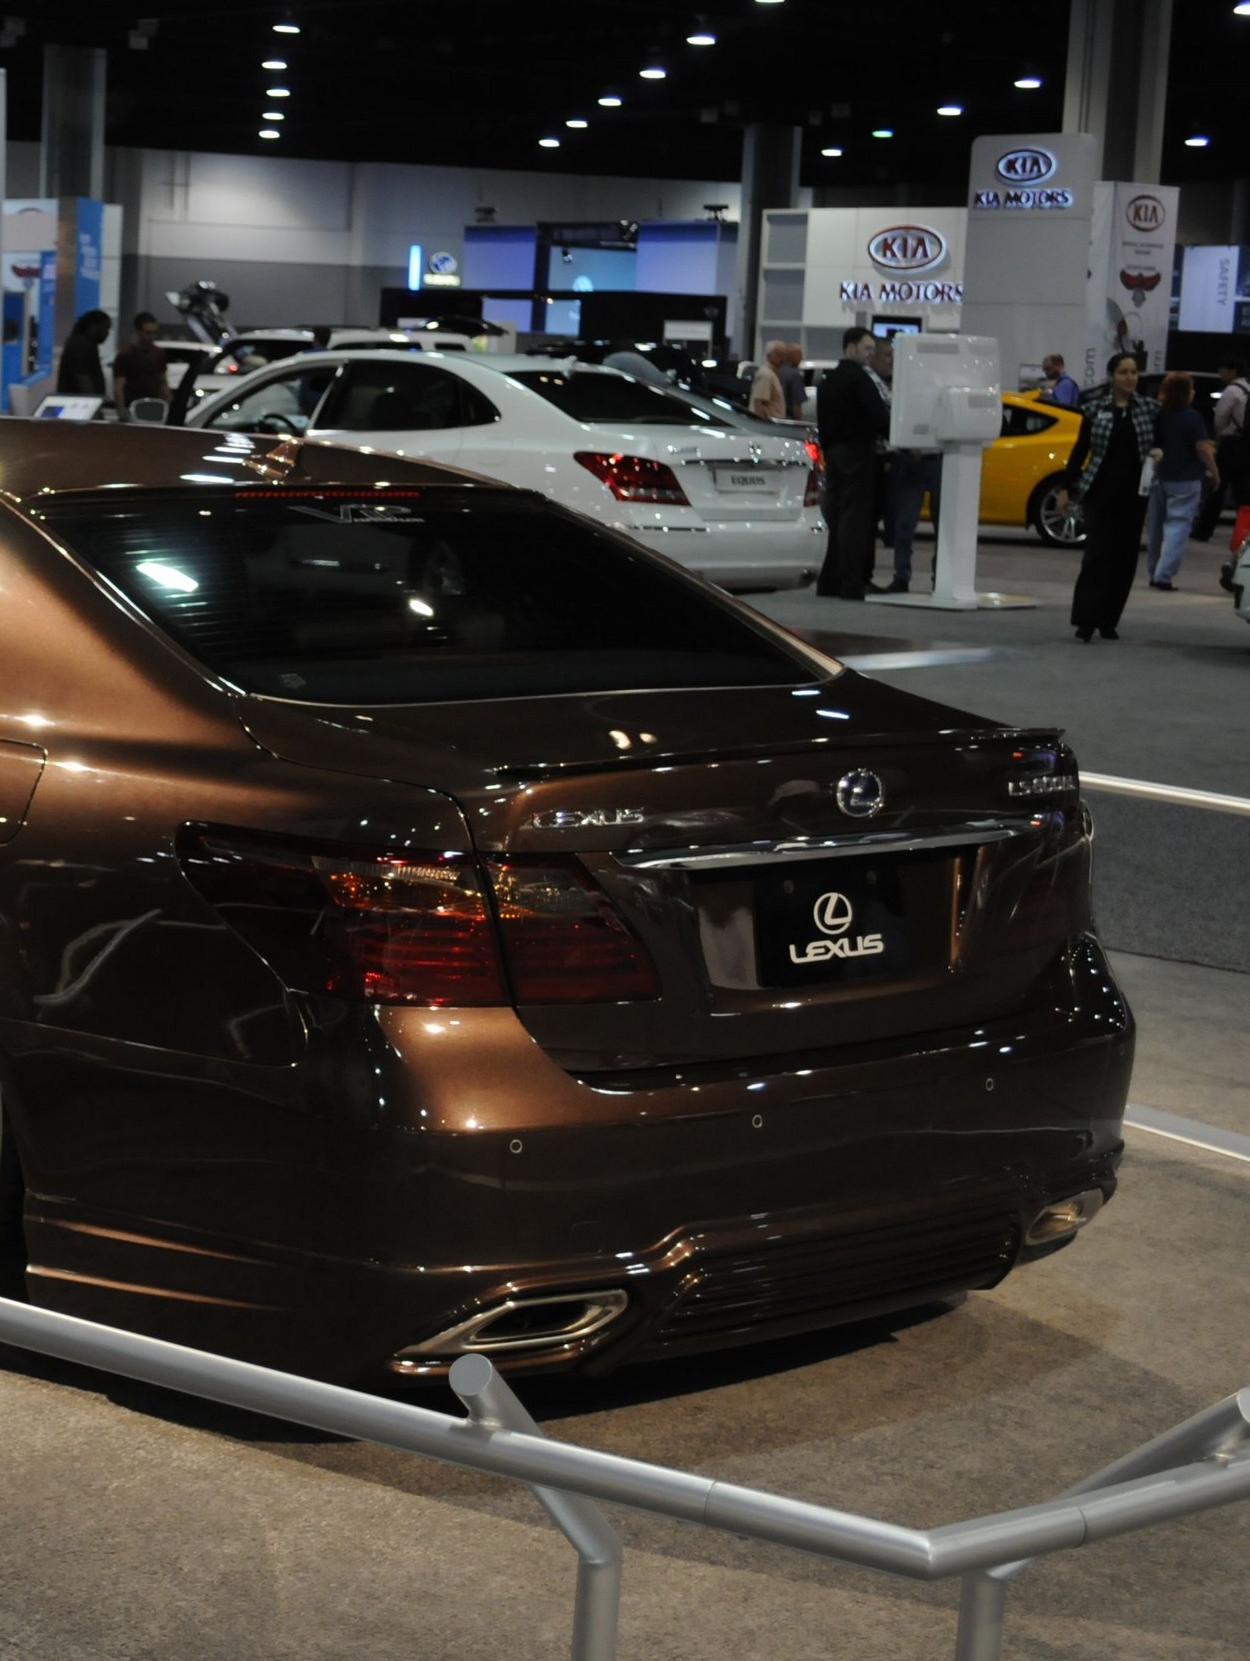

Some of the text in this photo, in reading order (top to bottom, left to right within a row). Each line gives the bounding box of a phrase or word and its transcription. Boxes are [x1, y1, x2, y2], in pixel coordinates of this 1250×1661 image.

[975, 189, 1072, 207] KIA MOTORS
[1133, 203, 1159, 223] KIA
[840, 281, 963, 302] KIA MOTORS
[533, 807, 644, 829] LEXUS
[789, 933, 884, 964] LEXUS
